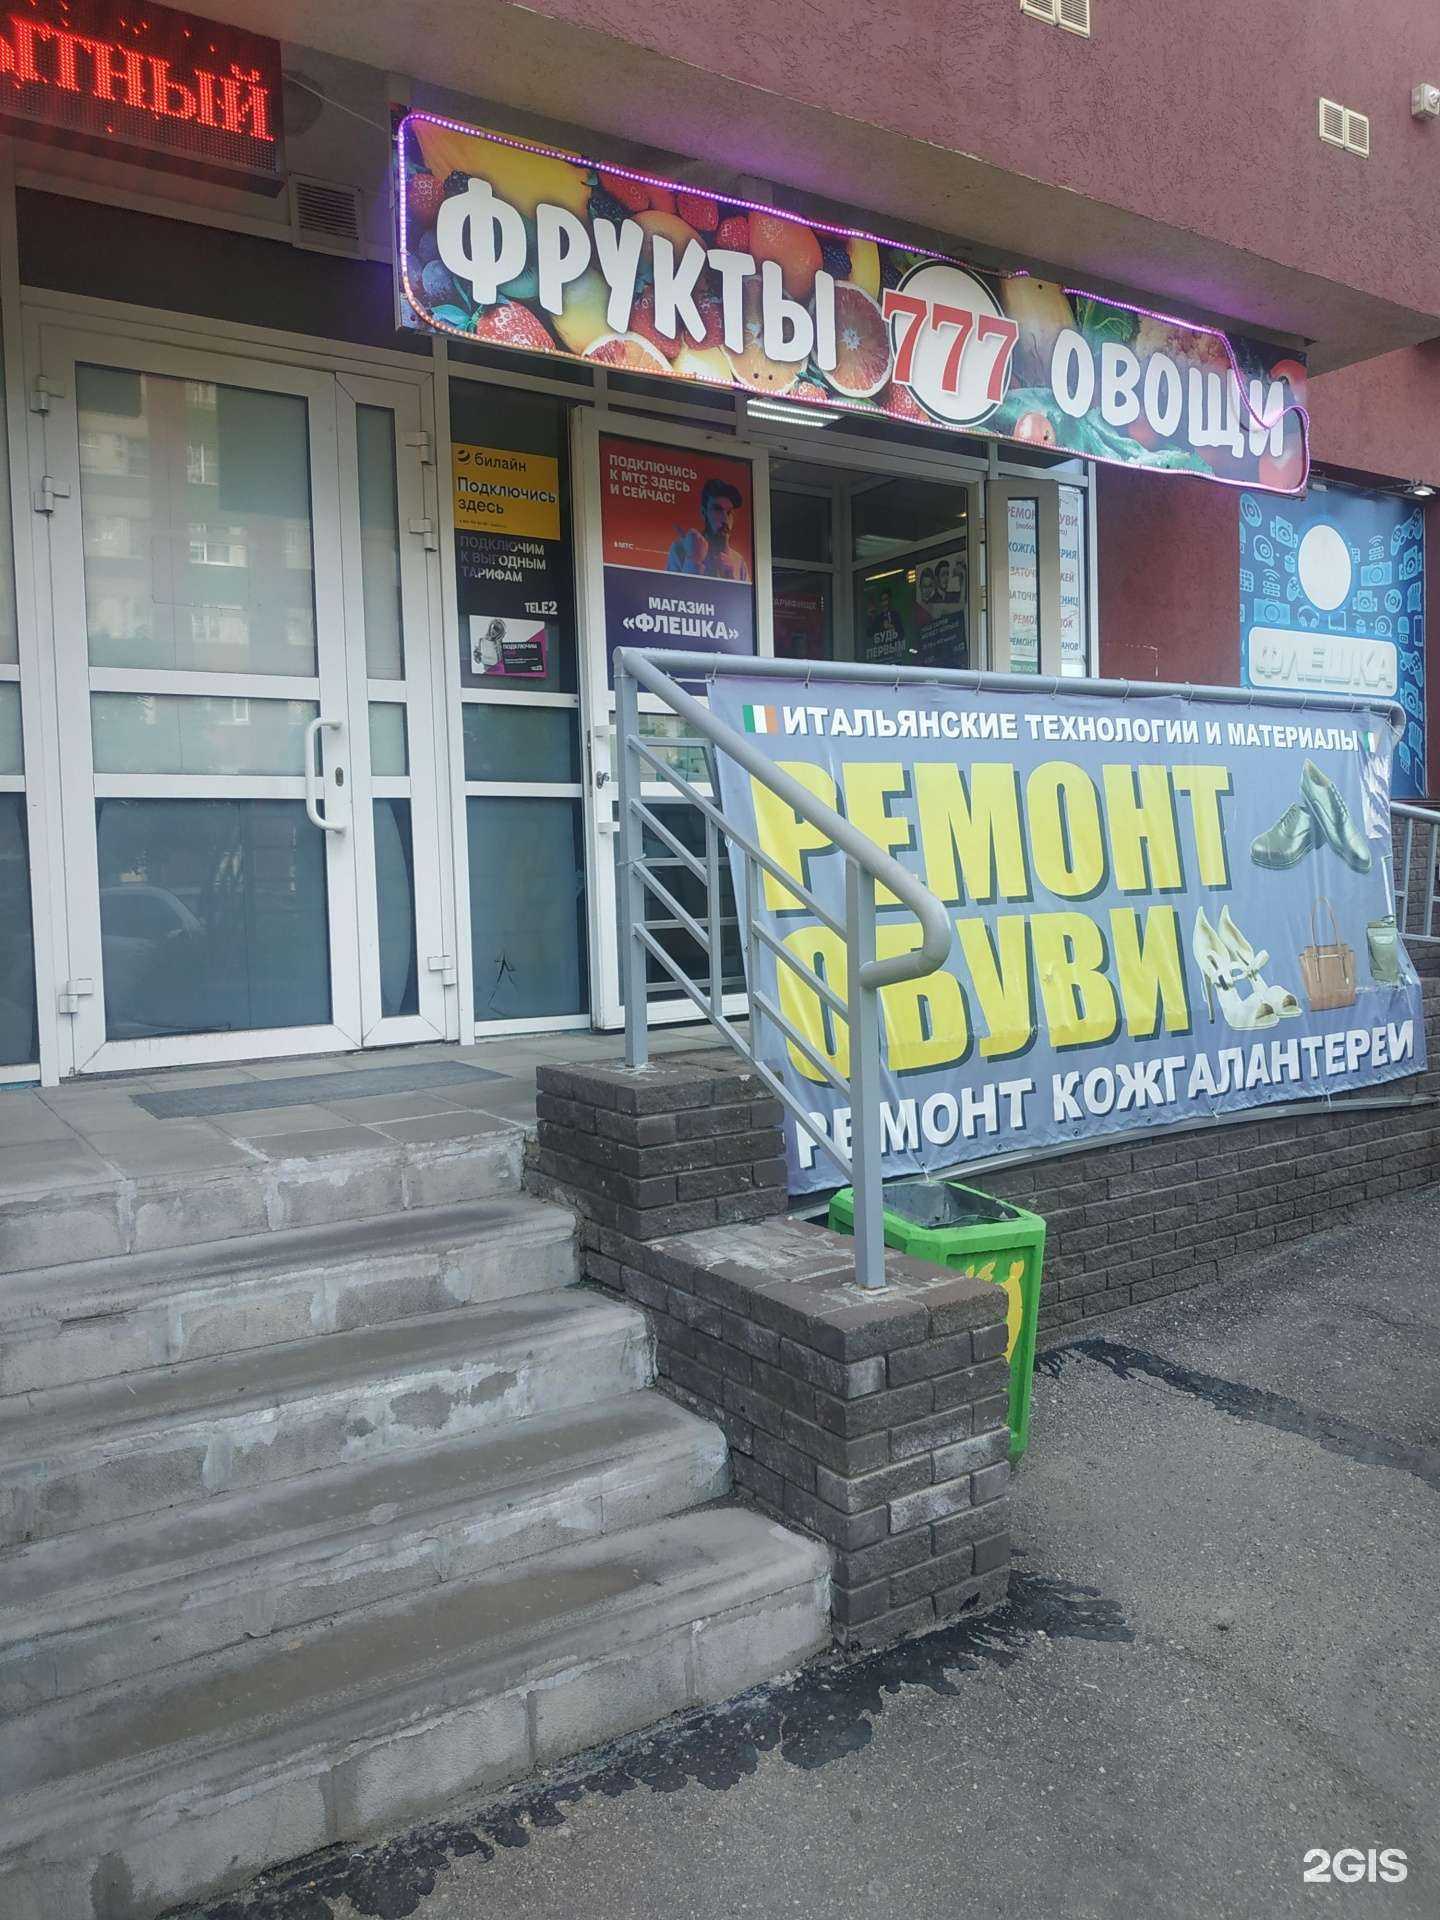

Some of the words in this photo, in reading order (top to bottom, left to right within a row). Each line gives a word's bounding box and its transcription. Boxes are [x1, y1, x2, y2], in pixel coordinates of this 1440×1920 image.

[437, 177, 838, 371] ФРУКТЫ
[883, 288, 1018, 404] 777
[1051, 329, 1285, 459] ОВОЩИ
[475, 453, 527, 472] билайн
[609, 454, 698, 480] ПОДКЛЮЧИСЬ
[457, 477, 557, 503] Подключись
[609, 469, 618, 480] К
[621, 471, 648, 485] МТС
[651, 478, 690, 493] ЗДЕСЬ
[610, 484, 619, 495] И
[622, 486, 675, 504] СЕЙЧАС!
[458, 499, 504, 514] здесь
[461, 536, 545, 555] ПОДКЛЮЧИМ
[460, 550, 468, 563] К
[472, 552, 547, 571] ВЫГОДНЫМ
[461, 566, 524, 583] ТАРИФАМ
[524, 601, 558, 615] TELE2
[648, 597, 715, 616] МАГАЗИН
[623, 613, 739, 640] «ФЛЕШКА»
[874, 631, 899, 645] БУДЬ
[866, 641, 907, 660] ПЕРВЫМ
[1256, 646, 1393, 689] ФЛЕШКА
[783, 706, 1018, 740] ИТАЛЬЯНСКИЕ
[1025, 714, 1199, 745] ТЕХНОЛОГИИ
[1205, 723, 1221, 745] И
[1228, 724, 1360, 752] МАТЕРИАЛЫ
[750, 760, 1233, 914] РЕМОНТ
[776, 904, 1190, 1083] ОБУВИ
